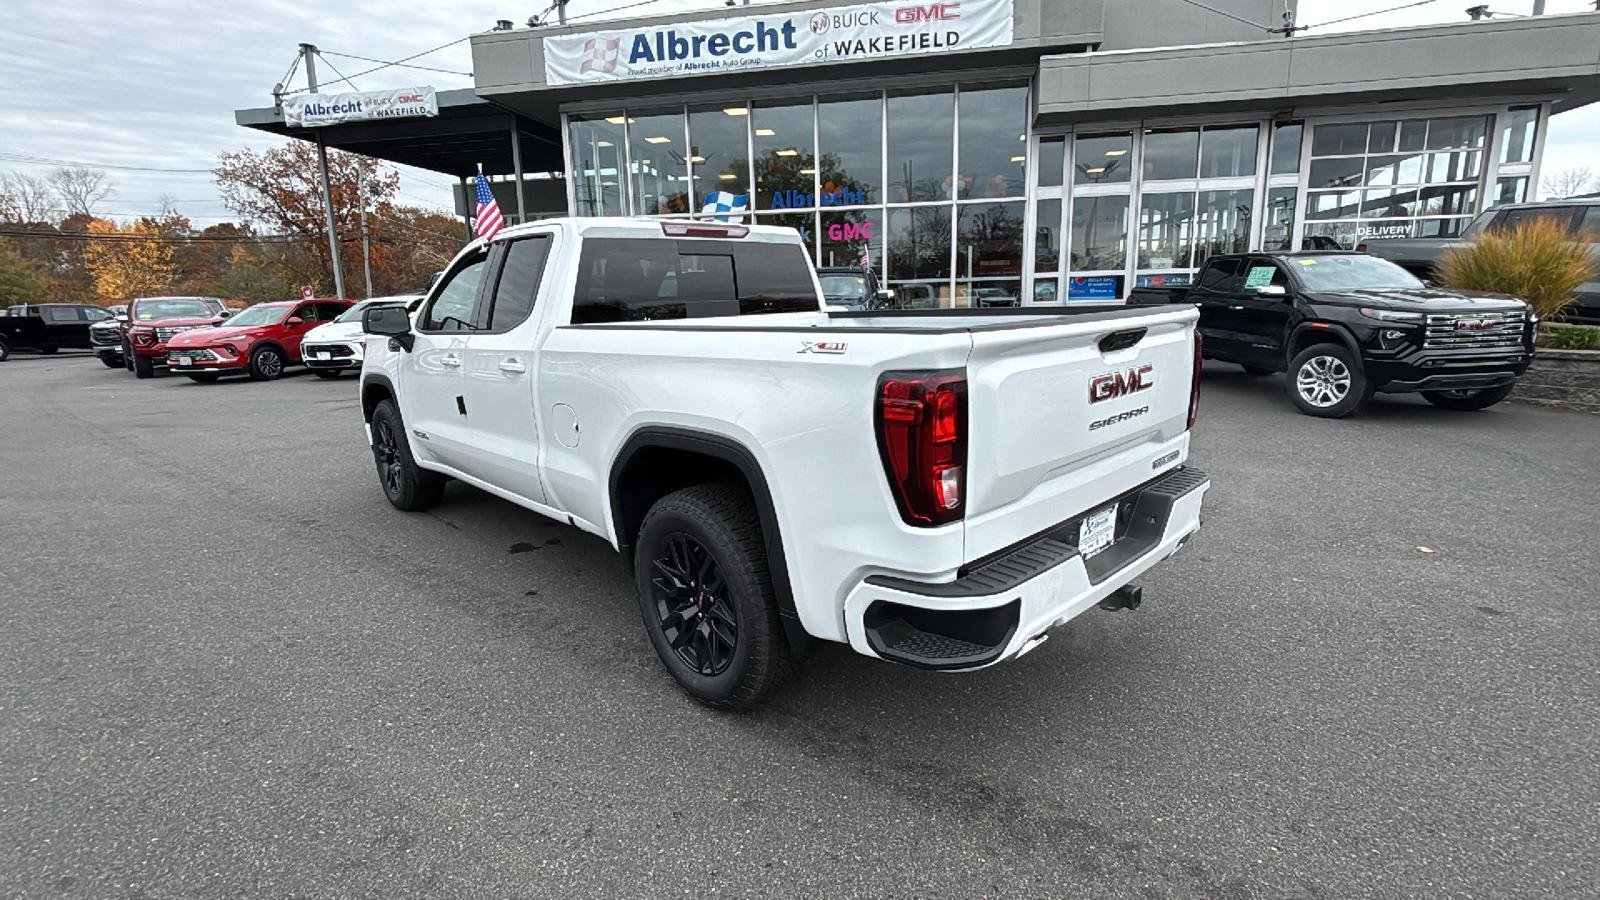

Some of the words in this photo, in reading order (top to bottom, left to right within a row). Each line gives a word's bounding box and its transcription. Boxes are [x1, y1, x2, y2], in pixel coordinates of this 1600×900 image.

[833, 11, 879, 29] BUICK
[894, 3, 961, 24] GMC
[628, 18, 798, 64] Albrecht
[815, 44, 829, 59] of
[834, 31, 960, 56] WAKEFIELD
[627, 67, 647, 76] Proud
[647, 64, 675, 75] member
[675, 63, 683, 72] of
[684, 60, 720, 71] Albrecht
[722, 58, 740, 67] Auto
[739, 57, 761, 66] Group
[304, 100, 363, 116] Albrecht
[398, 94, 424, 104] GMC
[376, 106, 427, 118] WAKEFIELD
[771, 186, 866, 209] Albrecht
[828, 222, 875, 241] GMC
[1357, 224, 1413, 236] DELIVERY
[1088, 363, 1154, 405] GMC
[1089, 405, 1149, 431] SIERRA
